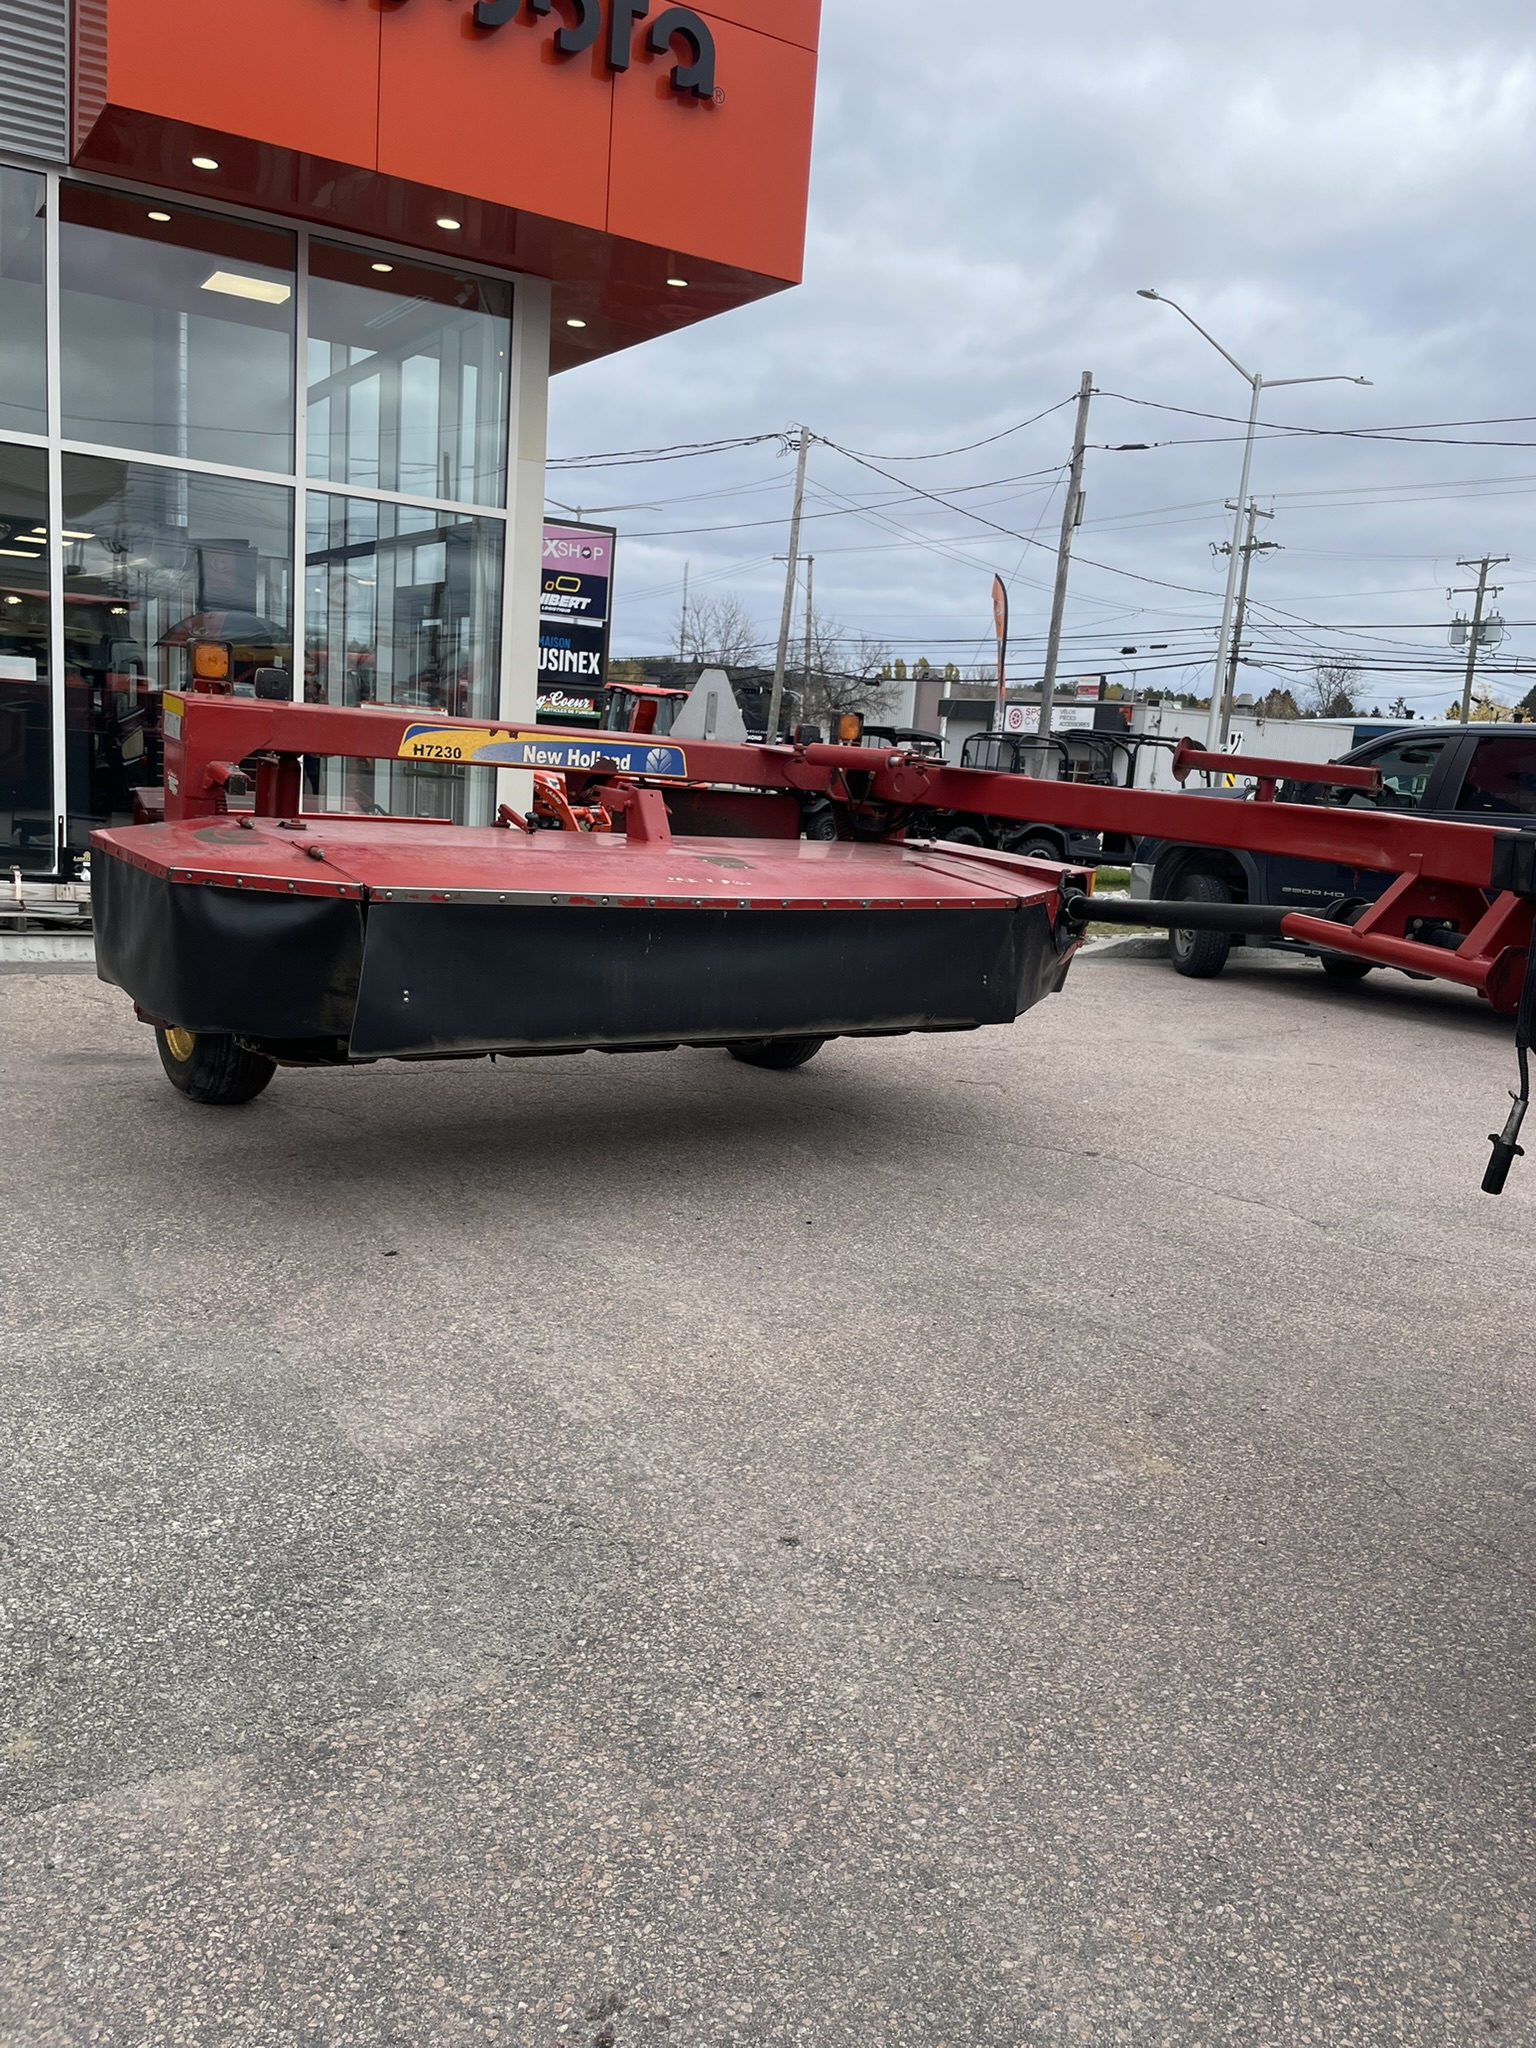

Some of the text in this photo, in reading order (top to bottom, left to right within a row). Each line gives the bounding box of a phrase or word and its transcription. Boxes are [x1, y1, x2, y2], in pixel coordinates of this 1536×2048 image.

[413, 743, 462, 759] H7230
[523, 744, 631, 771] New Holnd
[1323, 890, 1345, 898] HD
